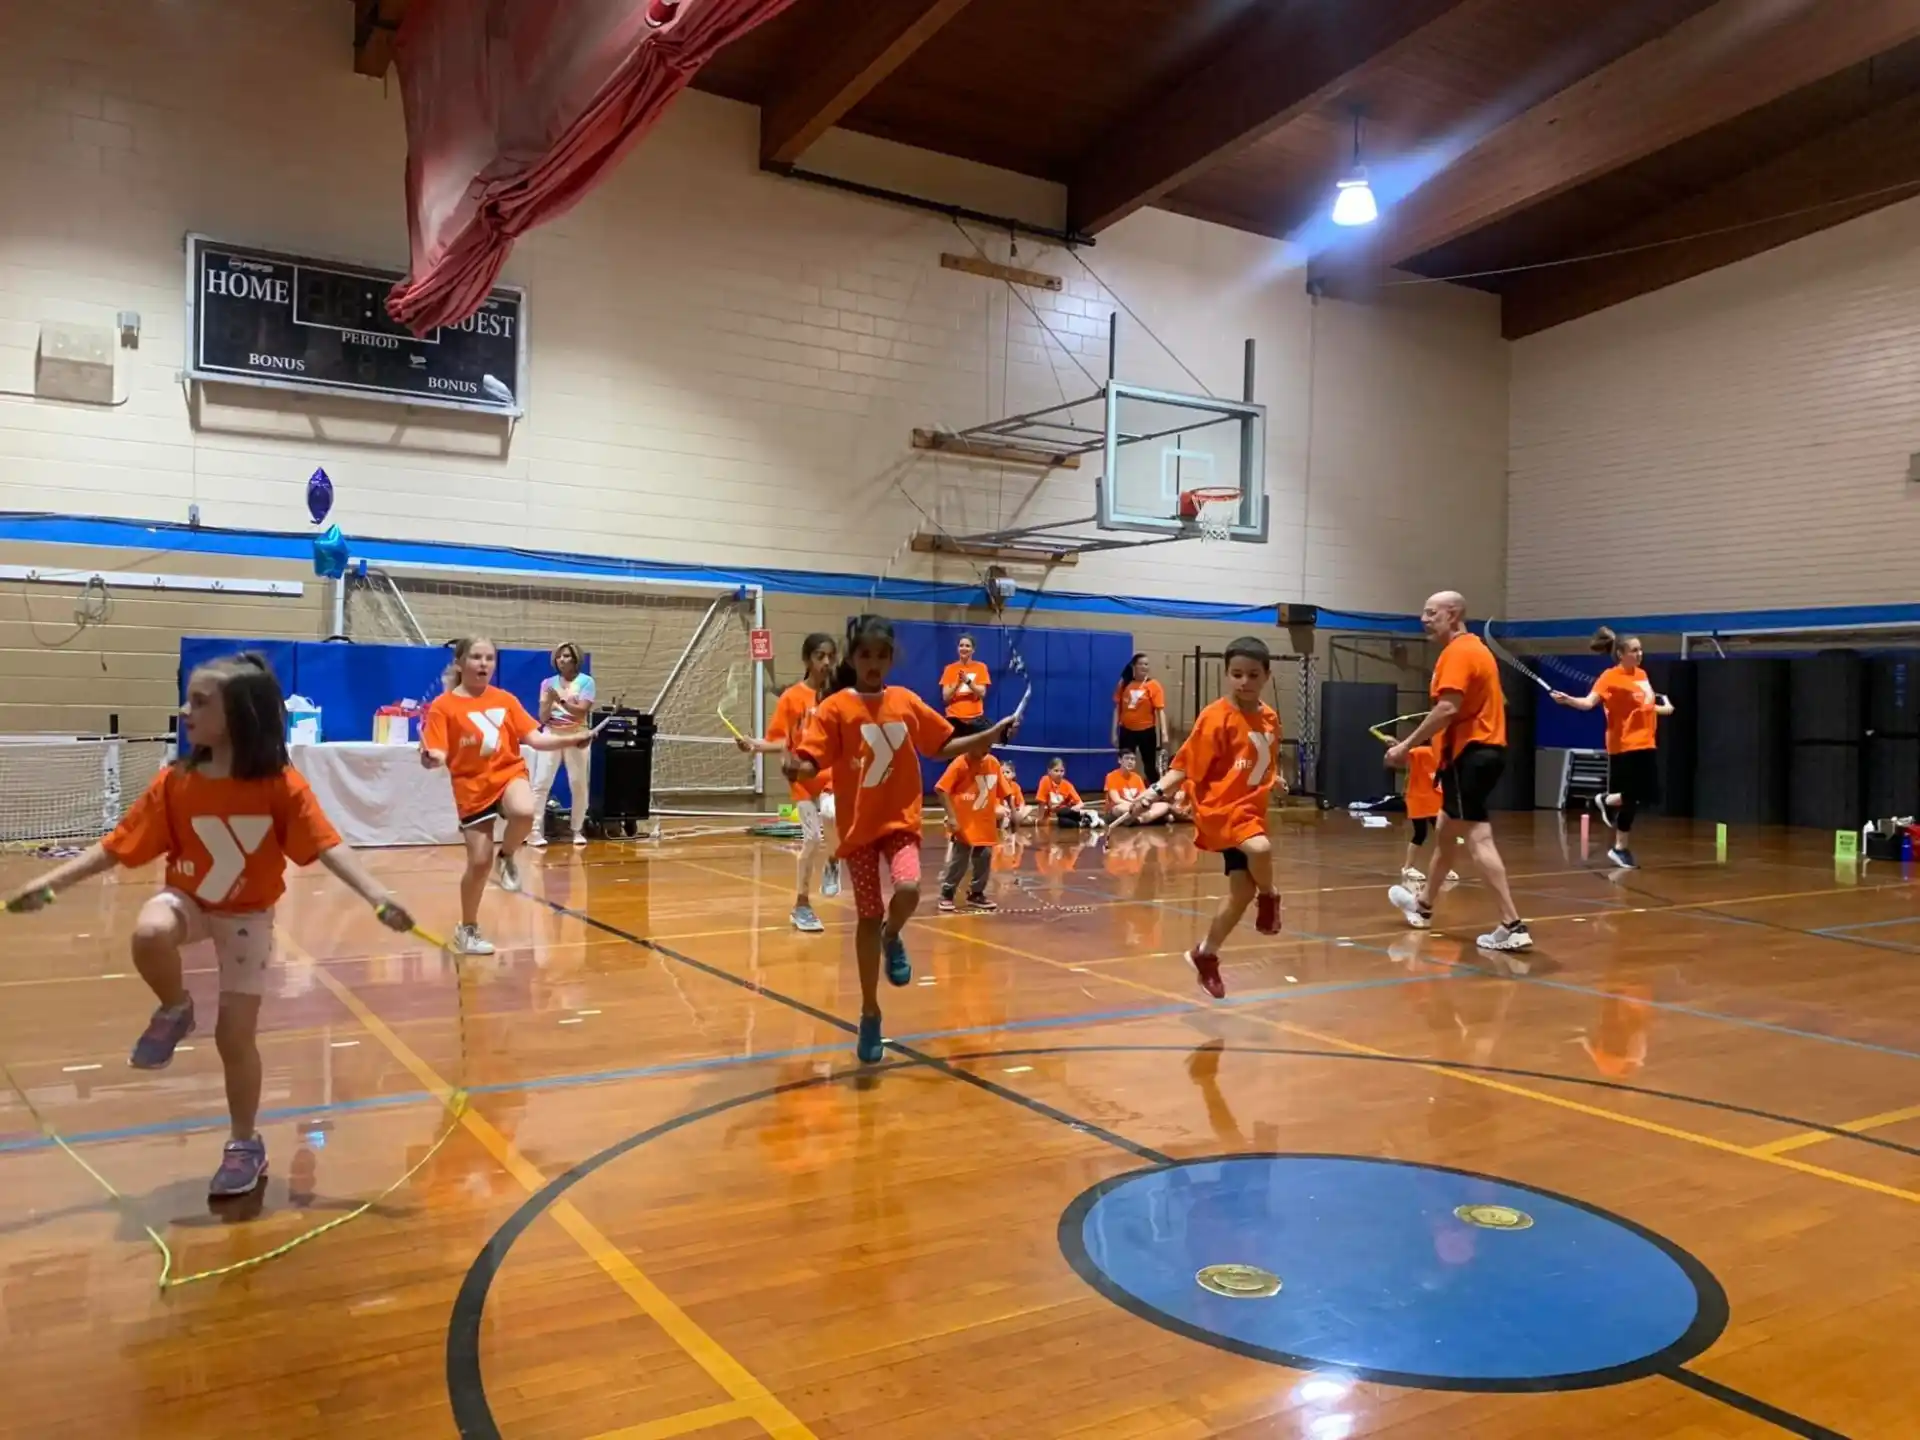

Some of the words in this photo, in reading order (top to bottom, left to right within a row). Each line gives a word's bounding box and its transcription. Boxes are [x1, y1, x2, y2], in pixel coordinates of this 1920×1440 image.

[207, 268, 289, 304] HOME
[447, 311, 514, 338] UEST
[341, 331, 399, 349] PERIOD
[248, 353, 305, 371] BONUS
[428, 376, 477, 394] BONUS
[860, 722, 908, 788] Y
[190, 814, 274, 903] Y
